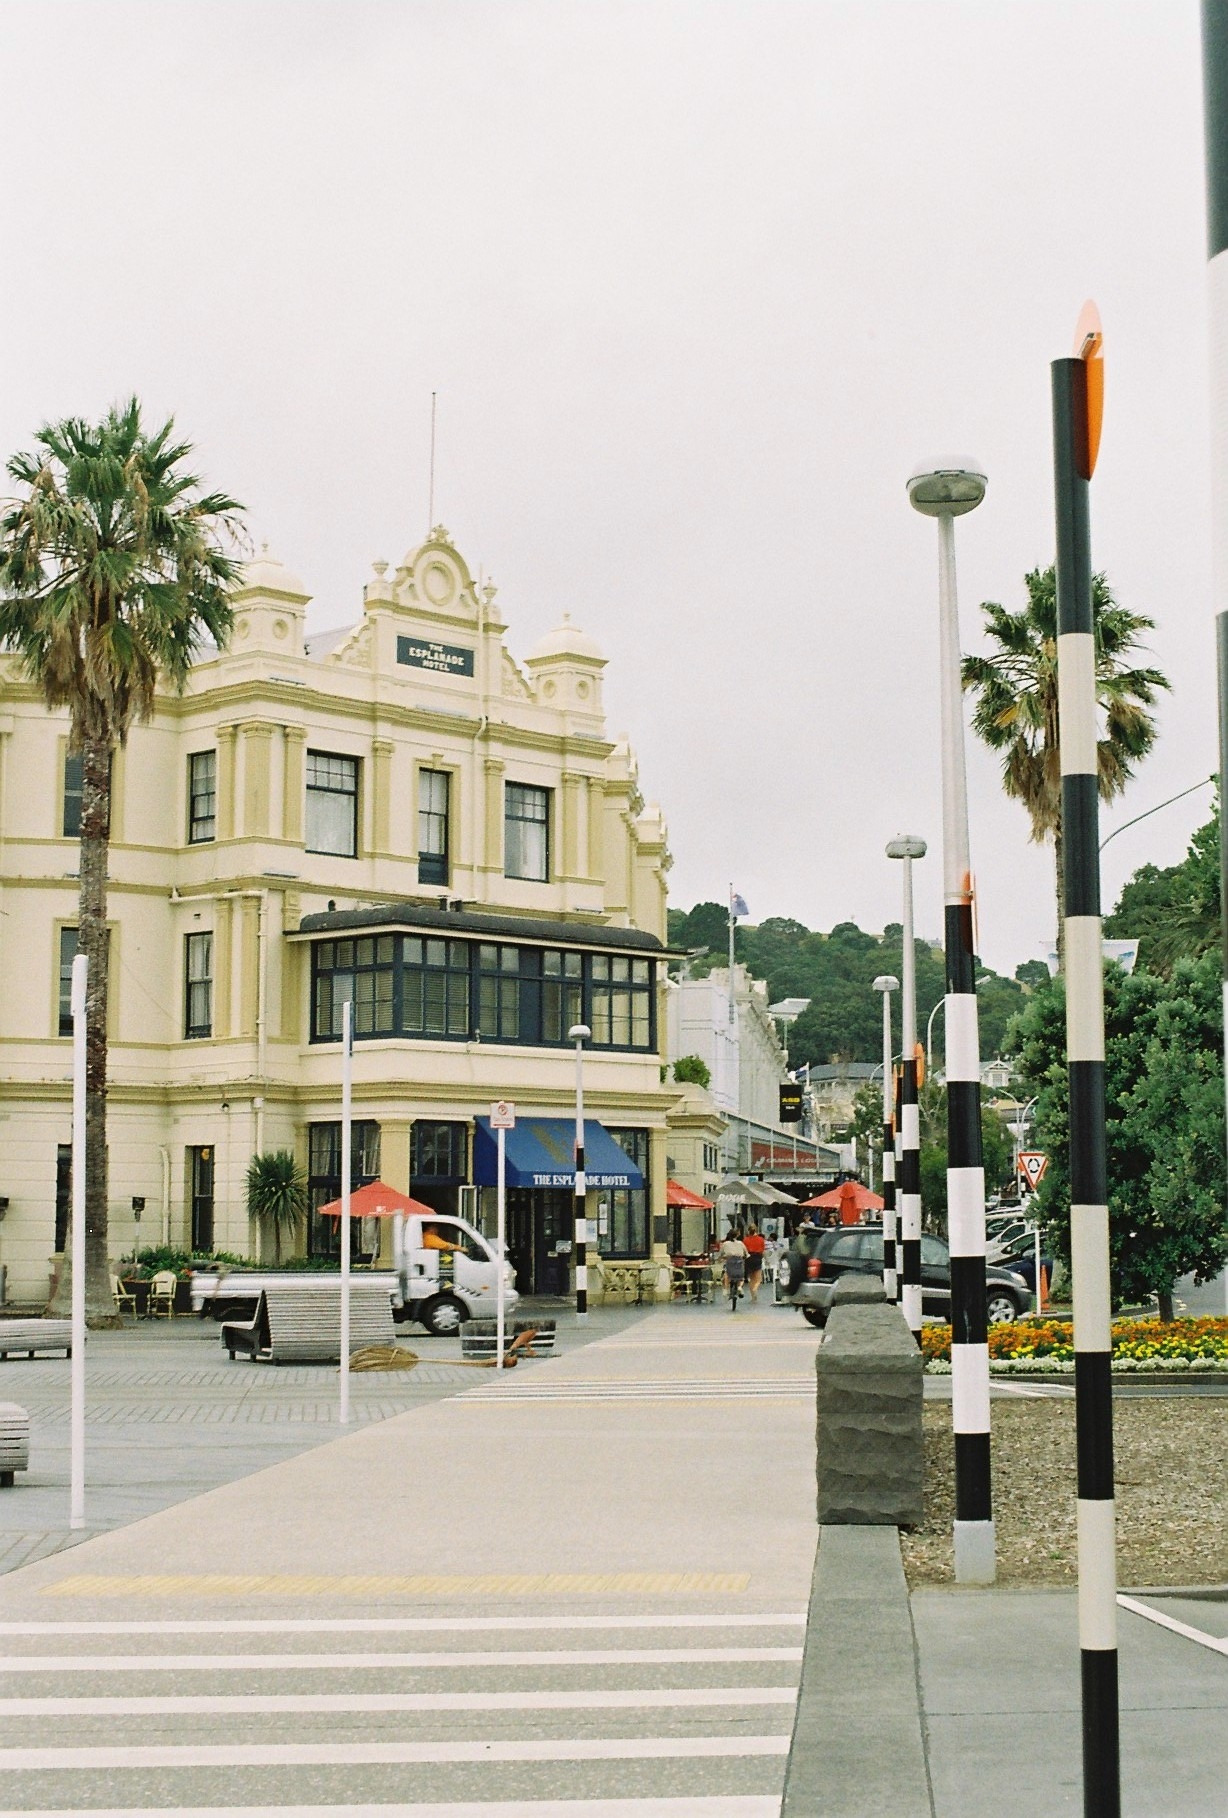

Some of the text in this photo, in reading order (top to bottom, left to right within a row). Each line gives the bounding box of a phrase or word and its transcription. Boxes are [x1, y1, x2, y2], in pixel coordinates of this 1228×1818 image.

[429, 644, 443, 652] THE
[409, 647, 465, 666] ESPLANADE
[422, 660, 450, 671] HOTEL
[533, 1174, 631, 1186] THE ESPLADE HOTEL
